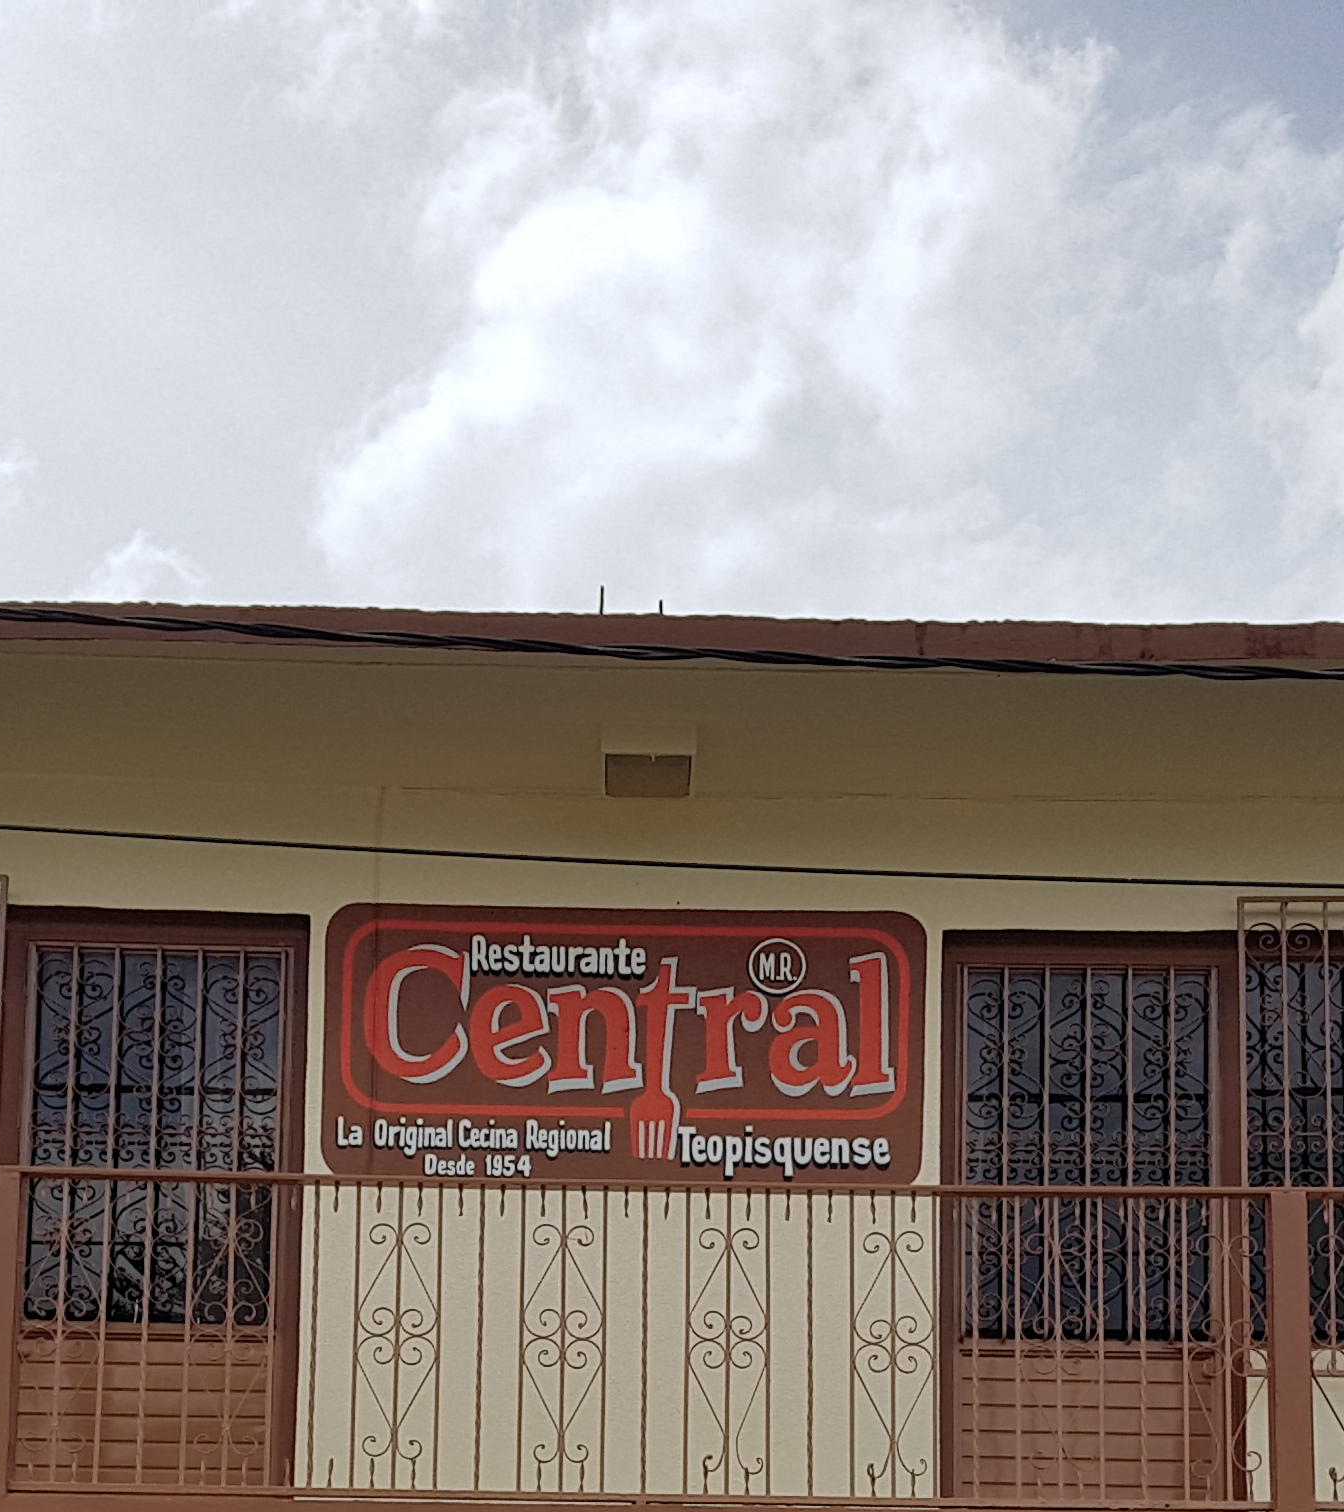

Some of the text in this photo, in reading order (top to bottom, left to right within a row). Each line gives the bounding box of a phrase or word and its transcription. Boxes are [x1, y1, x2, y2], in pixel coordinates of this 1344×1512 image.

[471, 934, 647, 976] Restaurante
[758, 952, 798, 982] M.R.
[364, 944, 896, 1159] Central
[336, 1116, 612, 1158] La Original Cecina Regional
[677, 1125, 892, 1178] Teopisquense
[424, 1154, 532, 1177] Desde 1954
